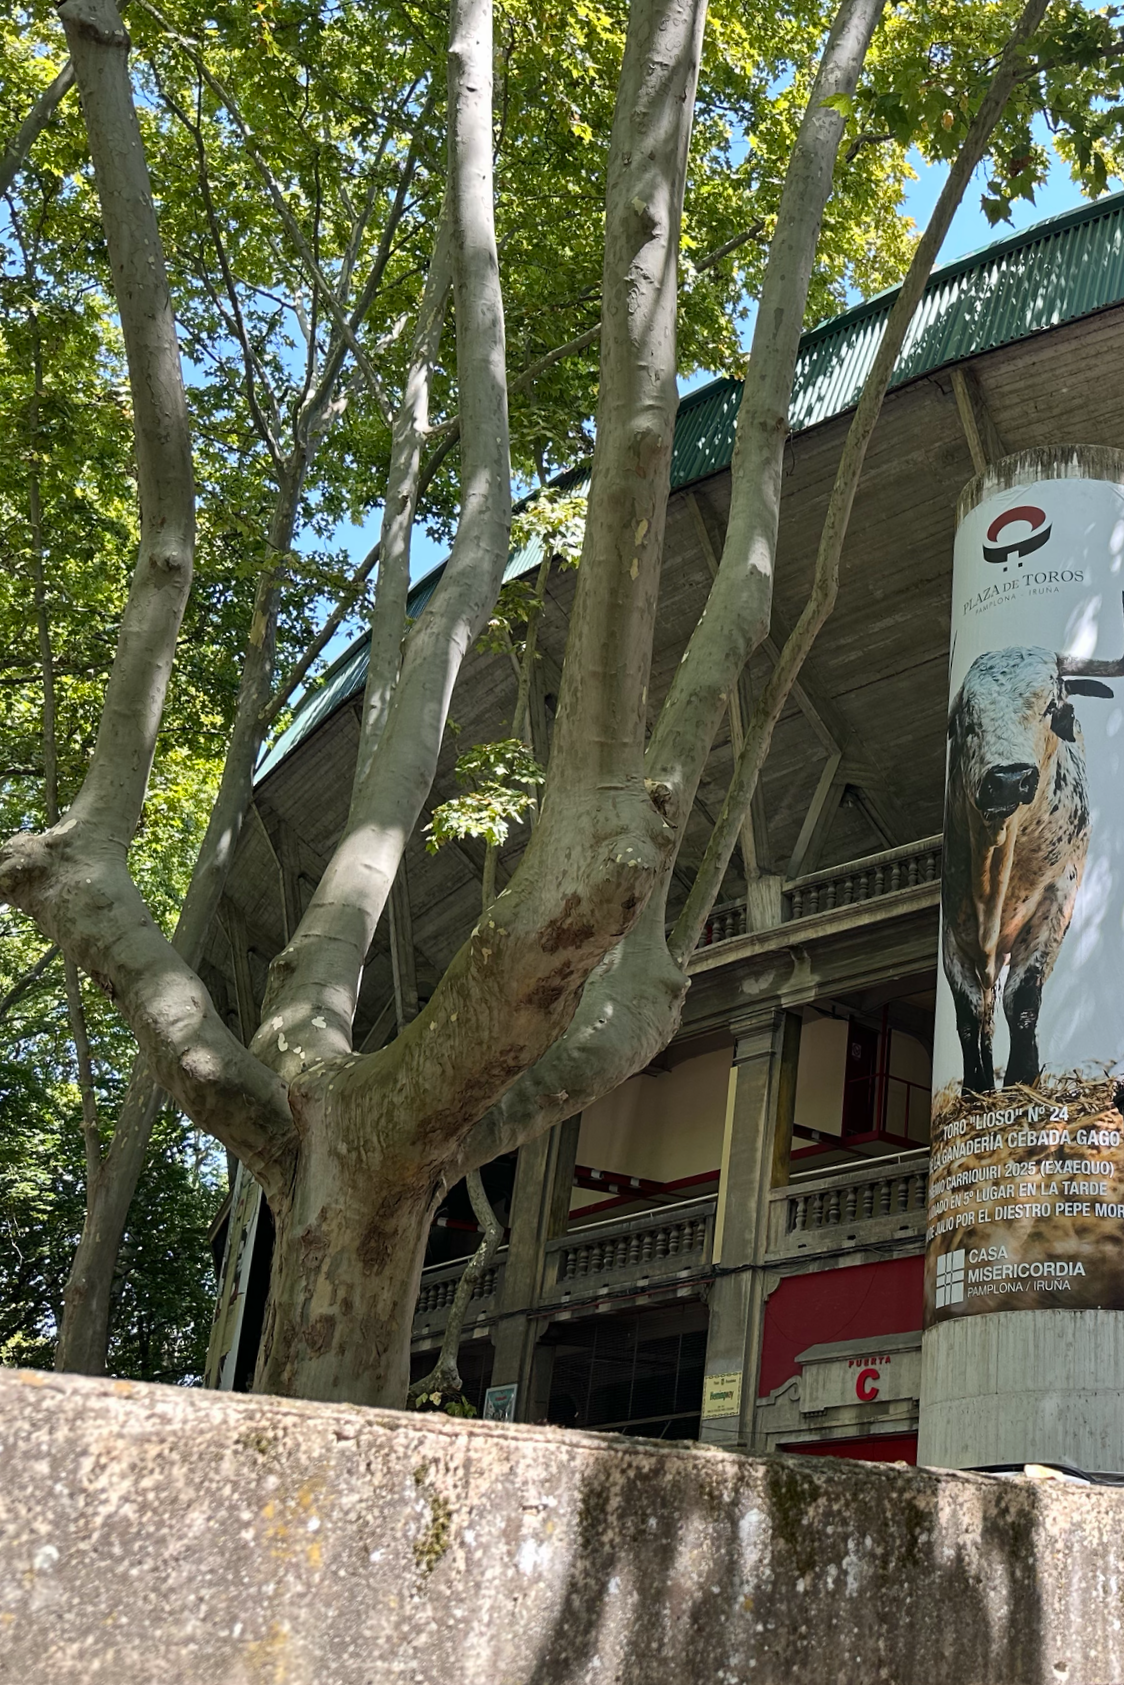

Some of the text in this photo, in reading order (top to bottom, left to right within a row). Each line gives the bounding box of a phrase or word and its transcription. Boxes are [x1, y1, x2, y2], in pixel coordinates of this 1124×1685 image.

[962, 570, 1084, 616] PLAZA DE TOROS
[975, 594, 1016, 615] PAMPLONA
[1029, 585, 1059, 596] IRUÑA
[943, 1119, 966, 1141] TORO
[970, 1108, 1022, 1130] "LIOSO"
[1049, 1105, 1069, 1121] 24
[942, 1132, 1003, 1165] GANADERÍA
[1008, 1130, 1071, 1148] CEBADA
[1077, 1130, 1120, 1147] GAGO
[946, 1165, 1001, 1191] CARRIQUIRI
[1005, 1162, 1036, 1177] 2025
[1040, 1160, 1115, 1178] (EXAEQUO)
[950, 1193, 962, 1209] EN
[976, 1184, 1015, 1203] LUGAR
[1019, 1182, 1036, 1197] EN
[1041, 1181, 1059, 1196] LA
[1062, 1181, 1108, 1196] TARDE
[935, 1216, 954, 1236] JULIO
[956, 1211, 975, 1228] POR
[978, 1208, 992, 1224] EL
[995, 1202, 1051, 1221] DIESTRO
[1055, 1202, 1091, 1217] PEPE
[968, 1245, 1009, 1264] CASA
[967, 1261, 1086, 1284] MISERICORDIA
[967, 1282, 1024, 1298] PAMPLONA
[1033, 1277, 1071, 1291] IRUÑA
[848, 1355, 891, 1369] PUERTA
[855, 1368, 880, 1402] C
